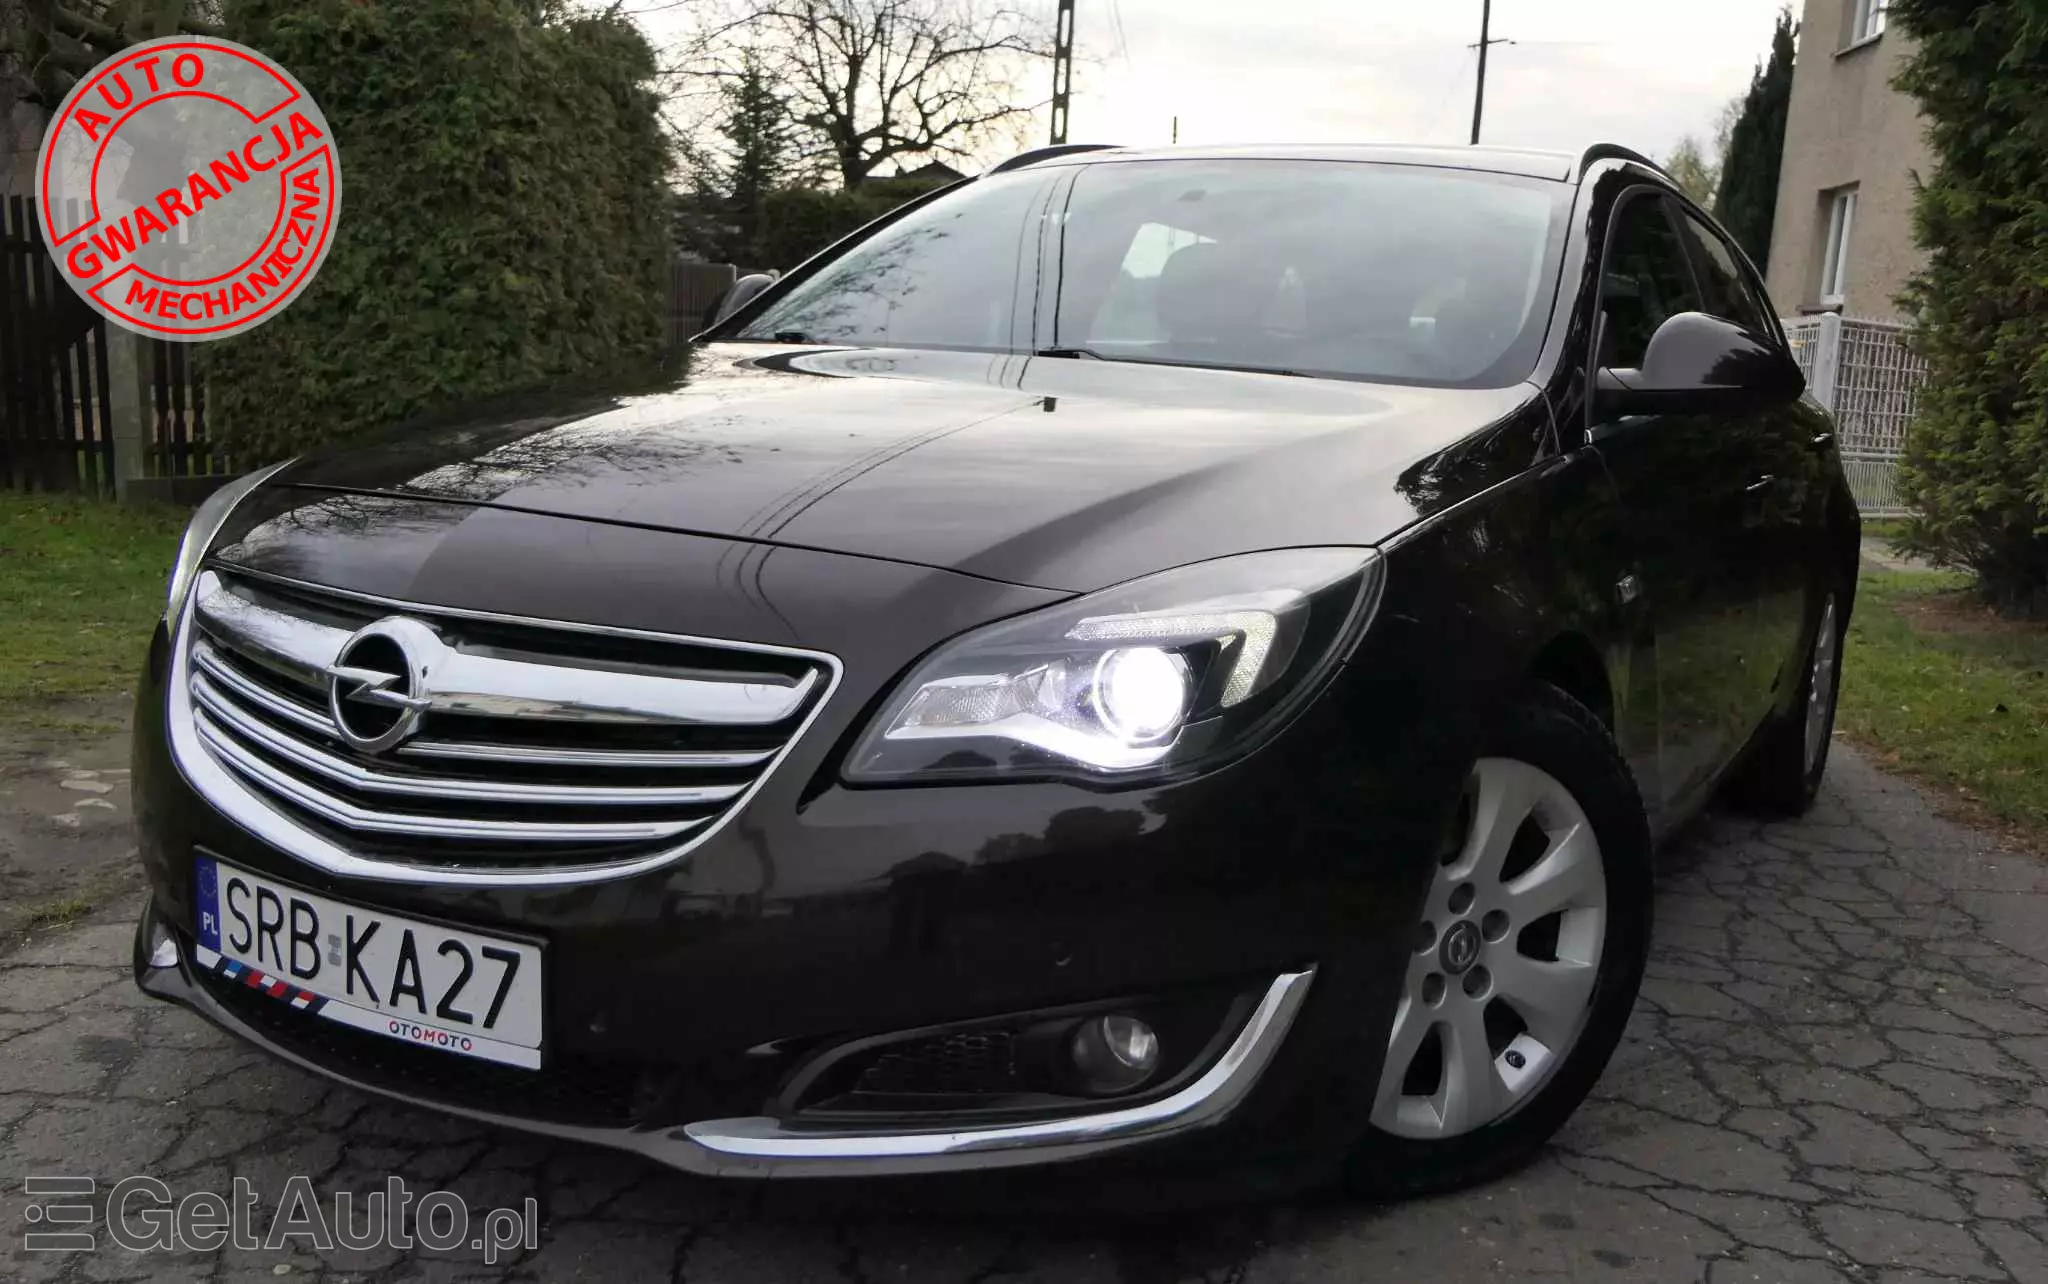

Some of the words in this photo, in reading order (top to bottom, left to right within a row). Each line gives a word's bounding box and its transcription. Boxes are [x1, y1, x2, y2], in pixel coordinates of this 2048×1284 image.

[203, 911, 218, 936] PL
[226, 877, 321, 980] SRB
[346, 915, 520, 1029] KA27
[388, 1020, 472, 1051] OTOMOTO
